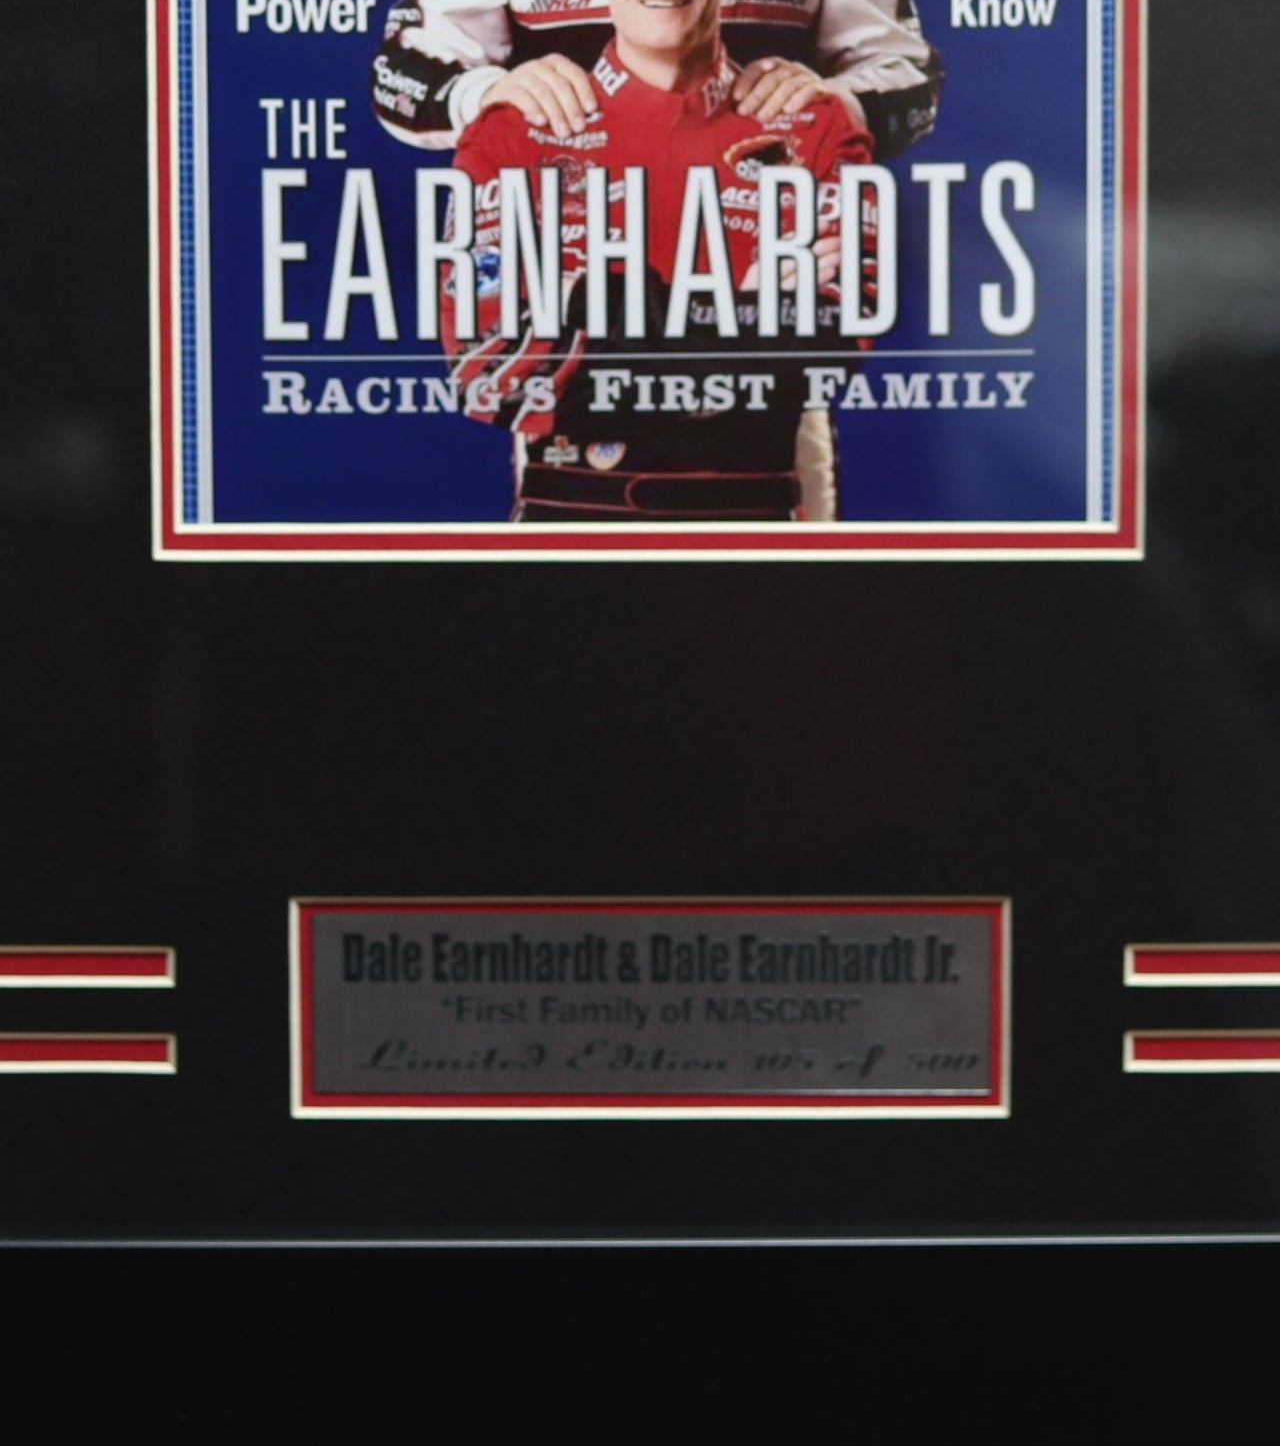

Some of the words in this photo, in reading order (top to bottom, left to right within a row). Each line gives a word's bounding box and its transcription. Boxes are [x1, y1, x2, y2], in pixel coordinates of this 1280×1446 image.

[260, 98, 347, 160] THE
[260, 161, 1036, 342] EARNHARDTS
[262, 369, 556, 416] RACING'S
[589, 367, 775, 411] FIRST
[803, 366, 1035, 410] FAMILY
[342, 931, 420, 985] Dale
[432, 931, 610, 985] Earnhardt
[615, 936, 642, 985] &
[649, 931, 730, 986] Dale
[738, 932, 917, 986] Earnhardt
[923, 932, 960, 986] Jr.
[539, 995, 650, 1032] Family
[659, 995, 694, 1025] of
[352, 1039, 547, 1073] Limited
[565, 1039, 728, 1073] Edition
